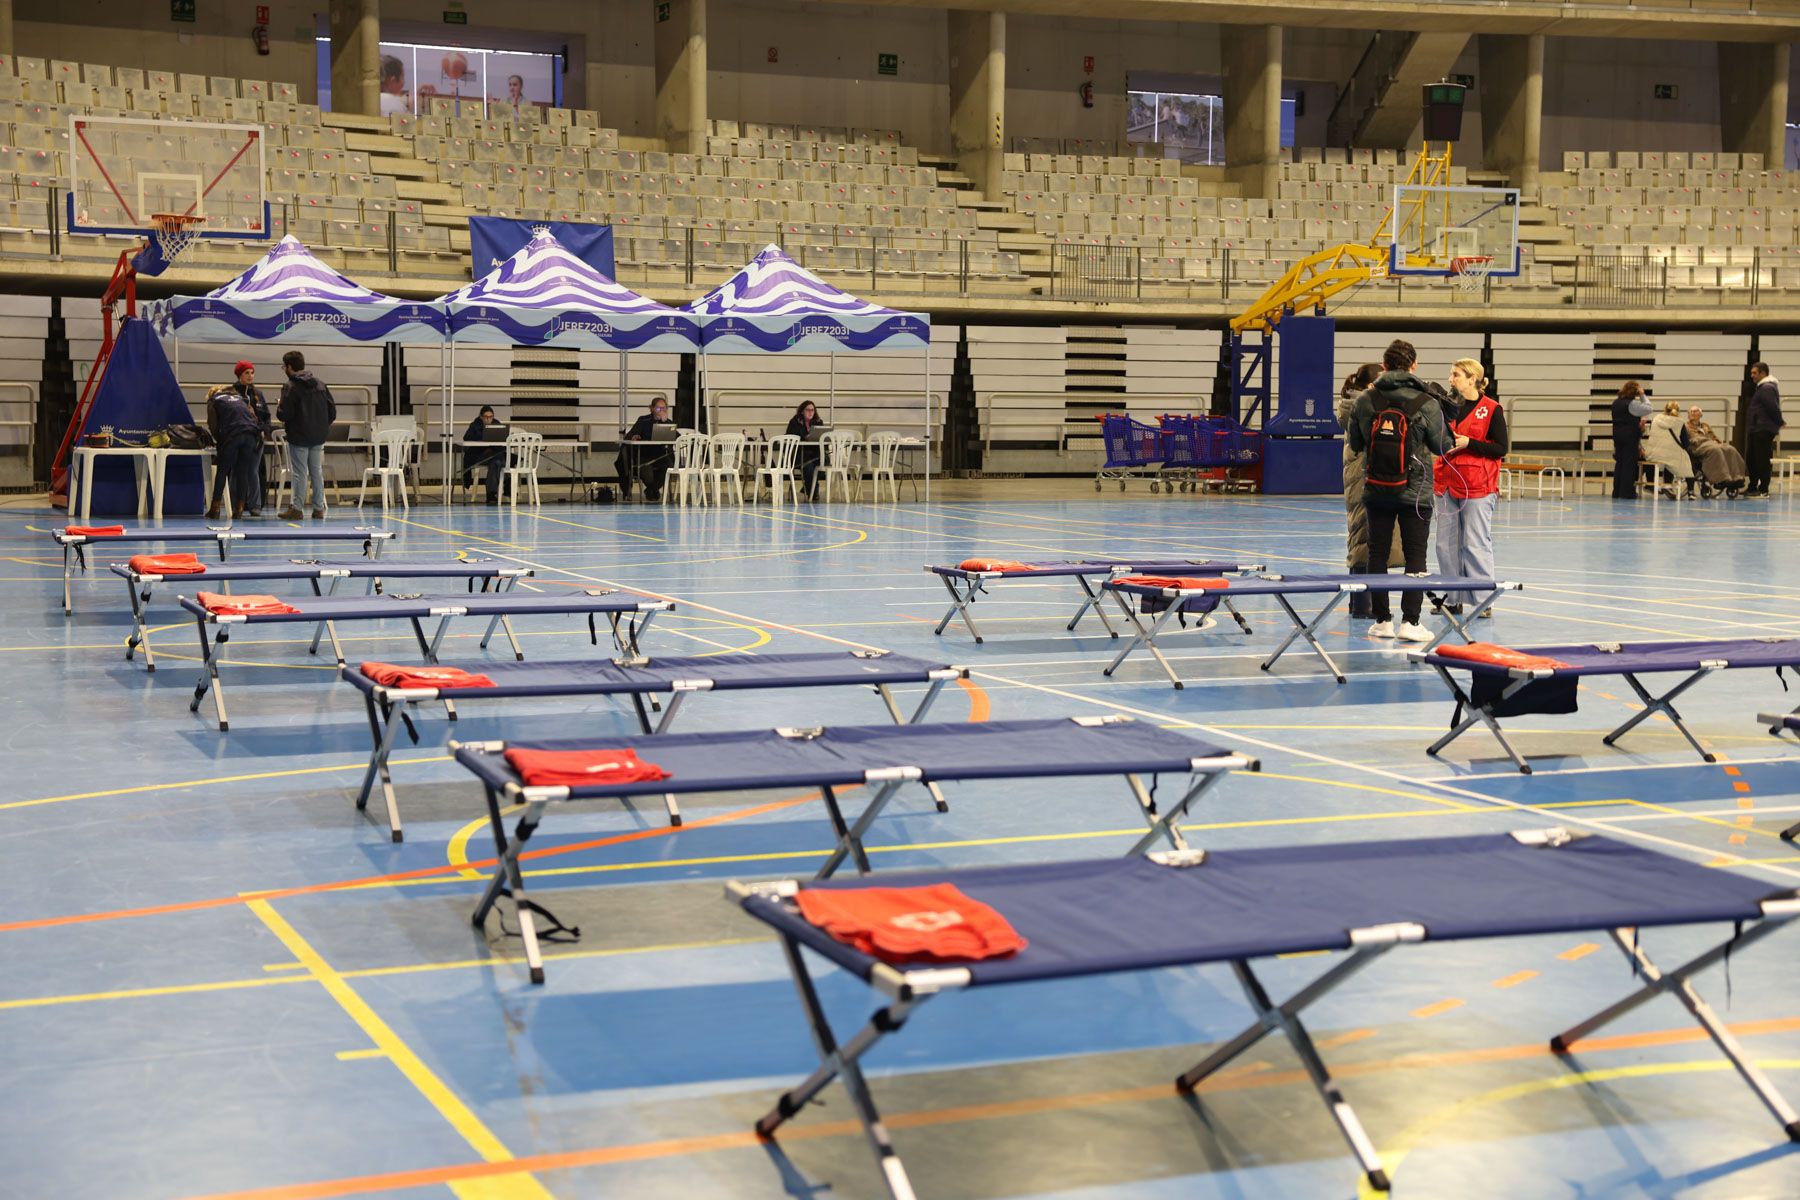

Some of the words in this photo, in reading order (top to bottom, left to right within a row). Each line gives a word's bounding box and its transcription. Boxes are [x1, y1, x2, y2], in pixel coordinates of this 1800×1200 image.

[292, 313, 351, 324] JEREZ2031
[559, 321, 613, 333] JEREZ2031
[801, 325, 850, 335] JEREZ2031
